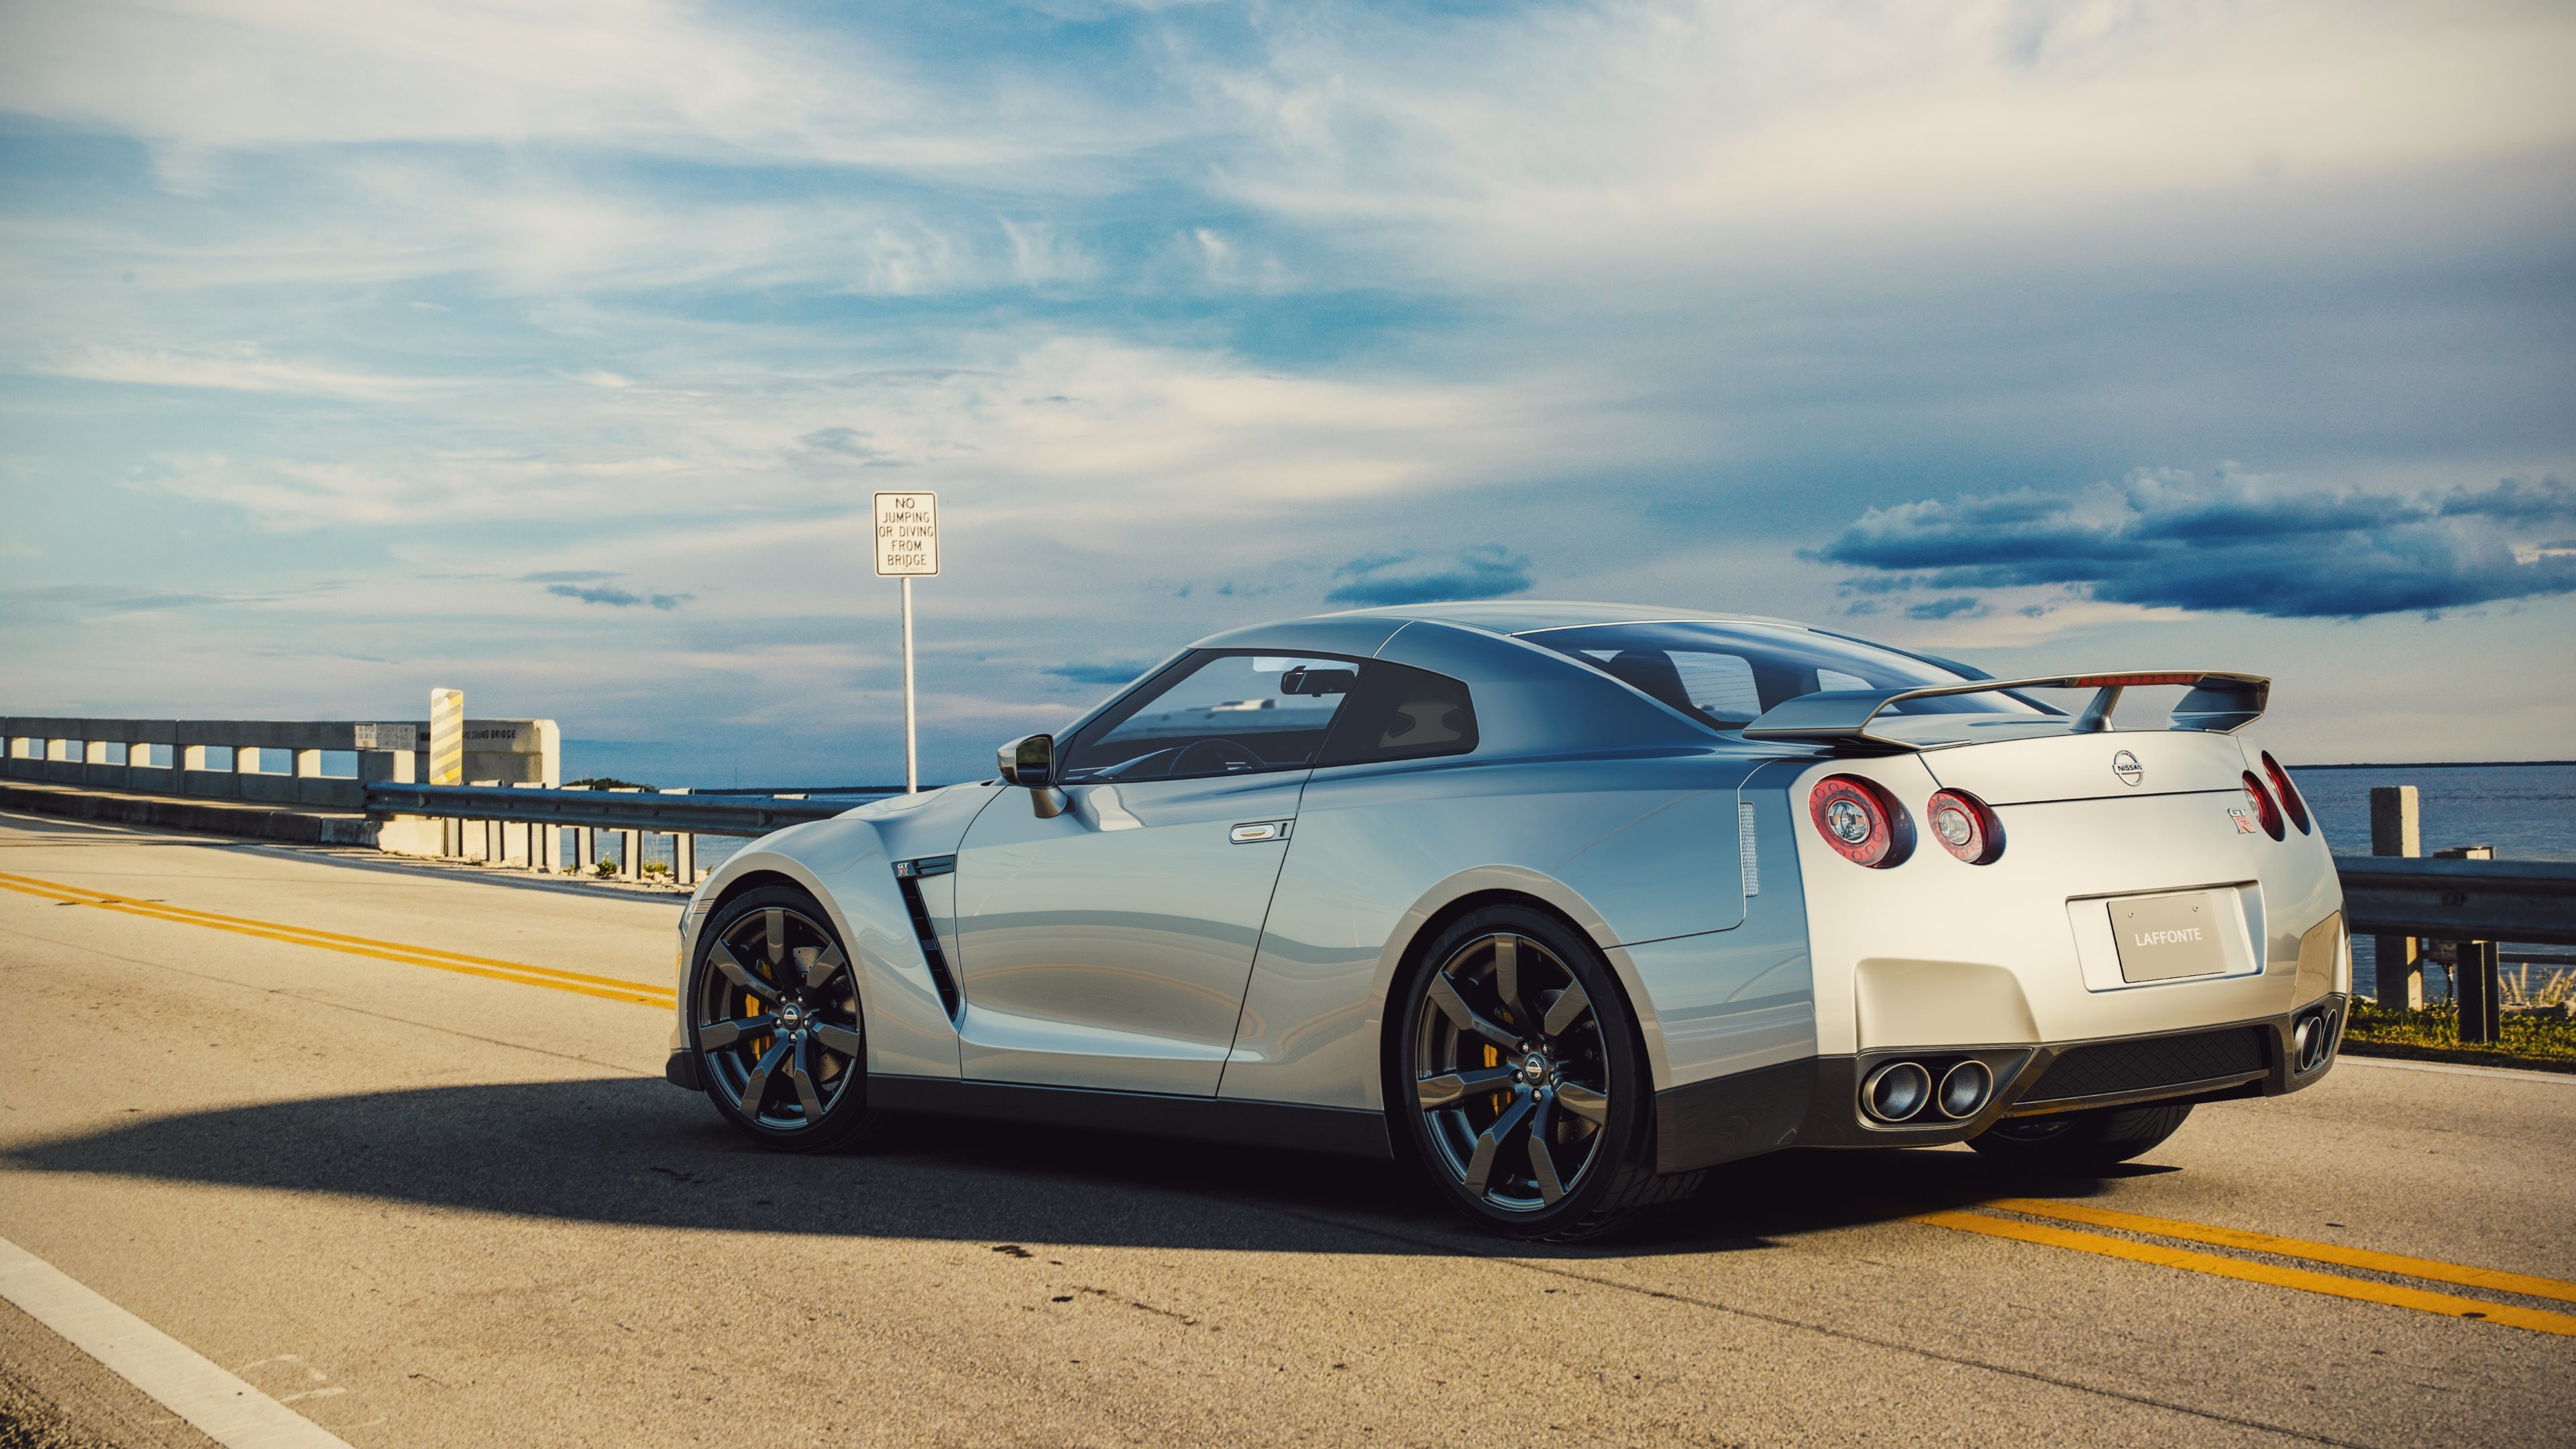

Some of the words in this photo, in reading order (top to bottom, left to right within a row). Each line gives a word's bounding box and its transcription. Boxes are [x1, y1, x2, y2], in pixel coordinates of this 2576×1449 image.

[896, 498, 915, 508] NO
[883, 512, 930, 523] JUMPING
[879, 526, 893, 537] OR
[899, 526, 934, 537] DIVING
[892, 540, 922, 551] FROM
[888, 554, 927, 566] BRIDGE
[491, 729, 516, 739] BRIDGE
[2135, 928, 2202, 947] LAFFONTE
